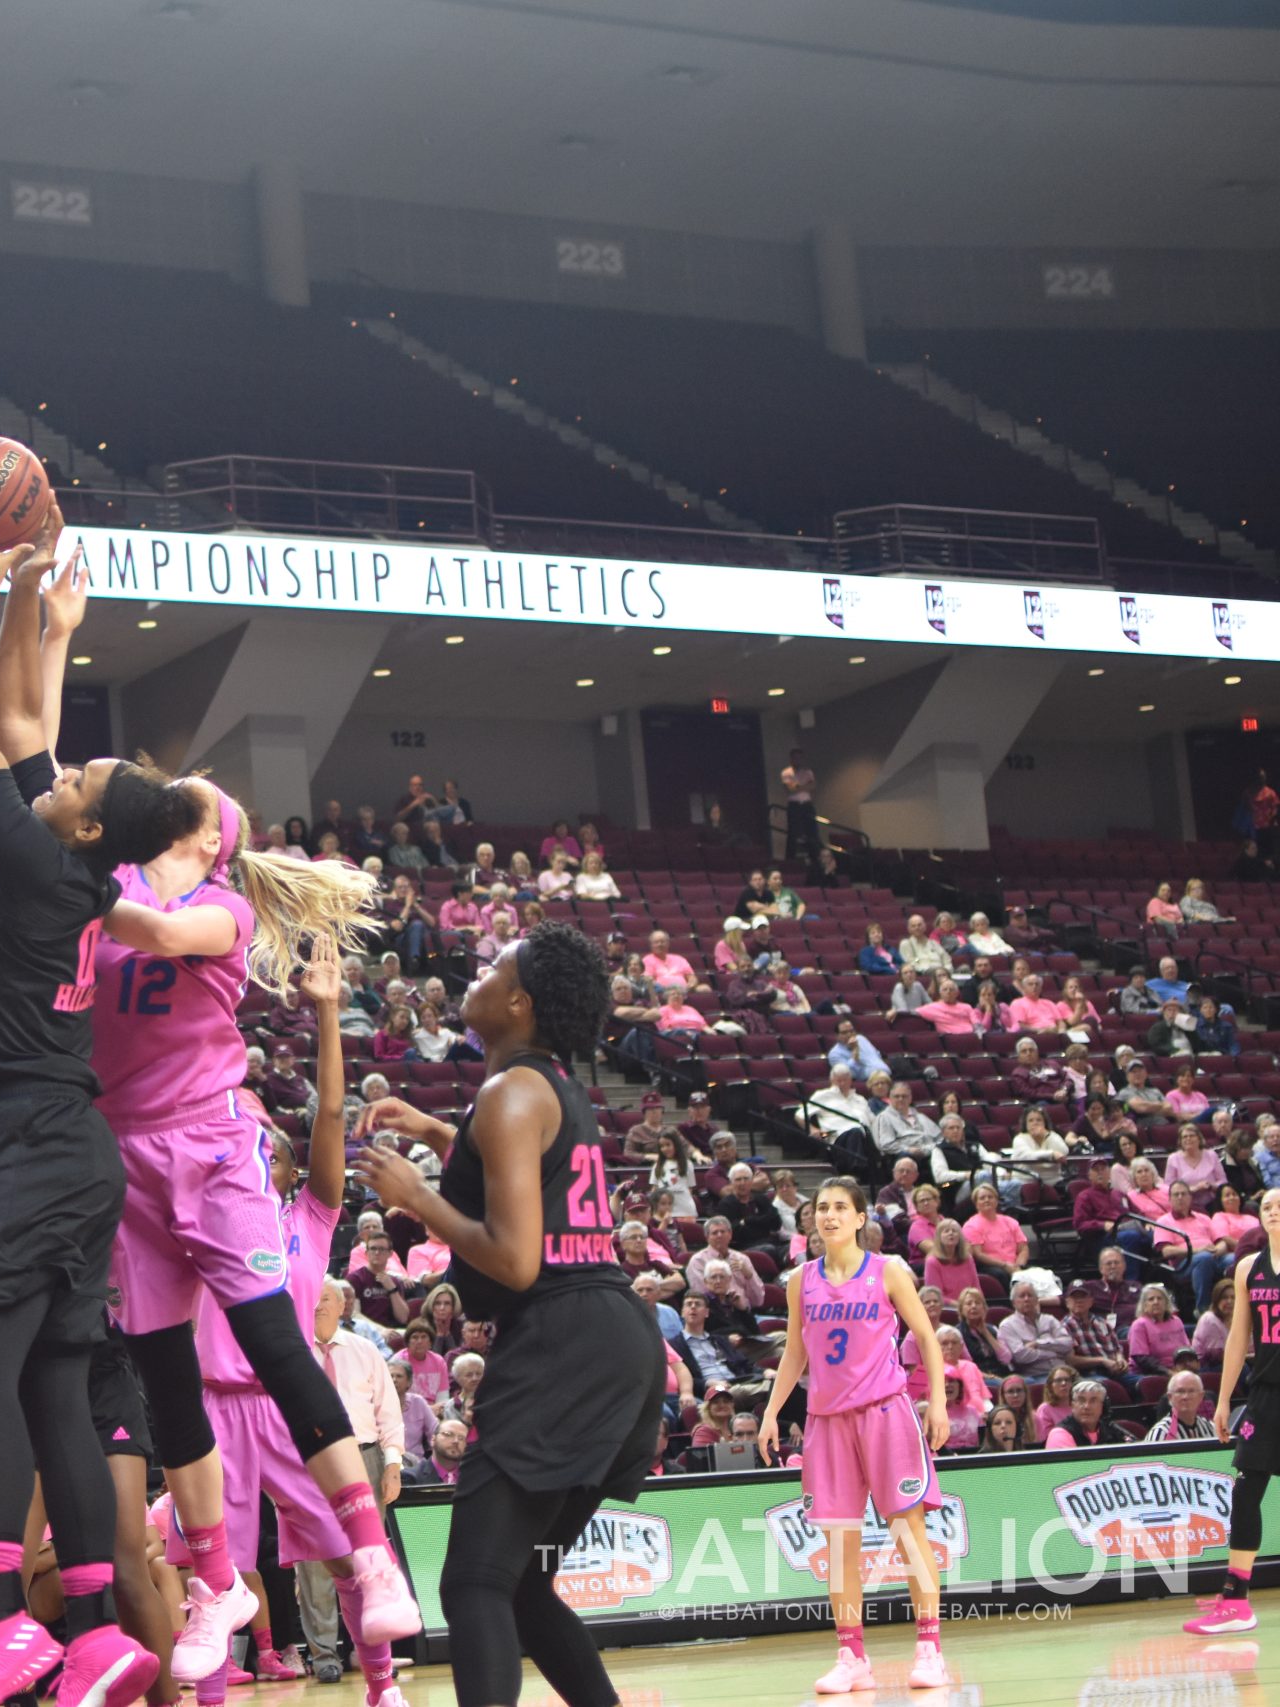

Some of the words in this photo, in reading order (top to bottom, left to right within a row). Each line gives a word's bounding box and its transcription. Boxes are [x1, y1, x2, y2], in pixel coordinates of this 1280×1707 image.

[14, 187, 91, 221] 222
[558, 242, 623, 274] 223
[1045, 268, 1113, 295] 224
[4, 536, 391, 603] AMPIONSHIP
[424, 556, 668, 620] ATHLETICS
[391, 731, 426, 748] 122
[117, 958, 178, 1015] 12
[567, 1144, 614, 1228] 21
[805, 1302, 880, 1322] FLORIDA
[825, 1328, 849, 1365] 3
